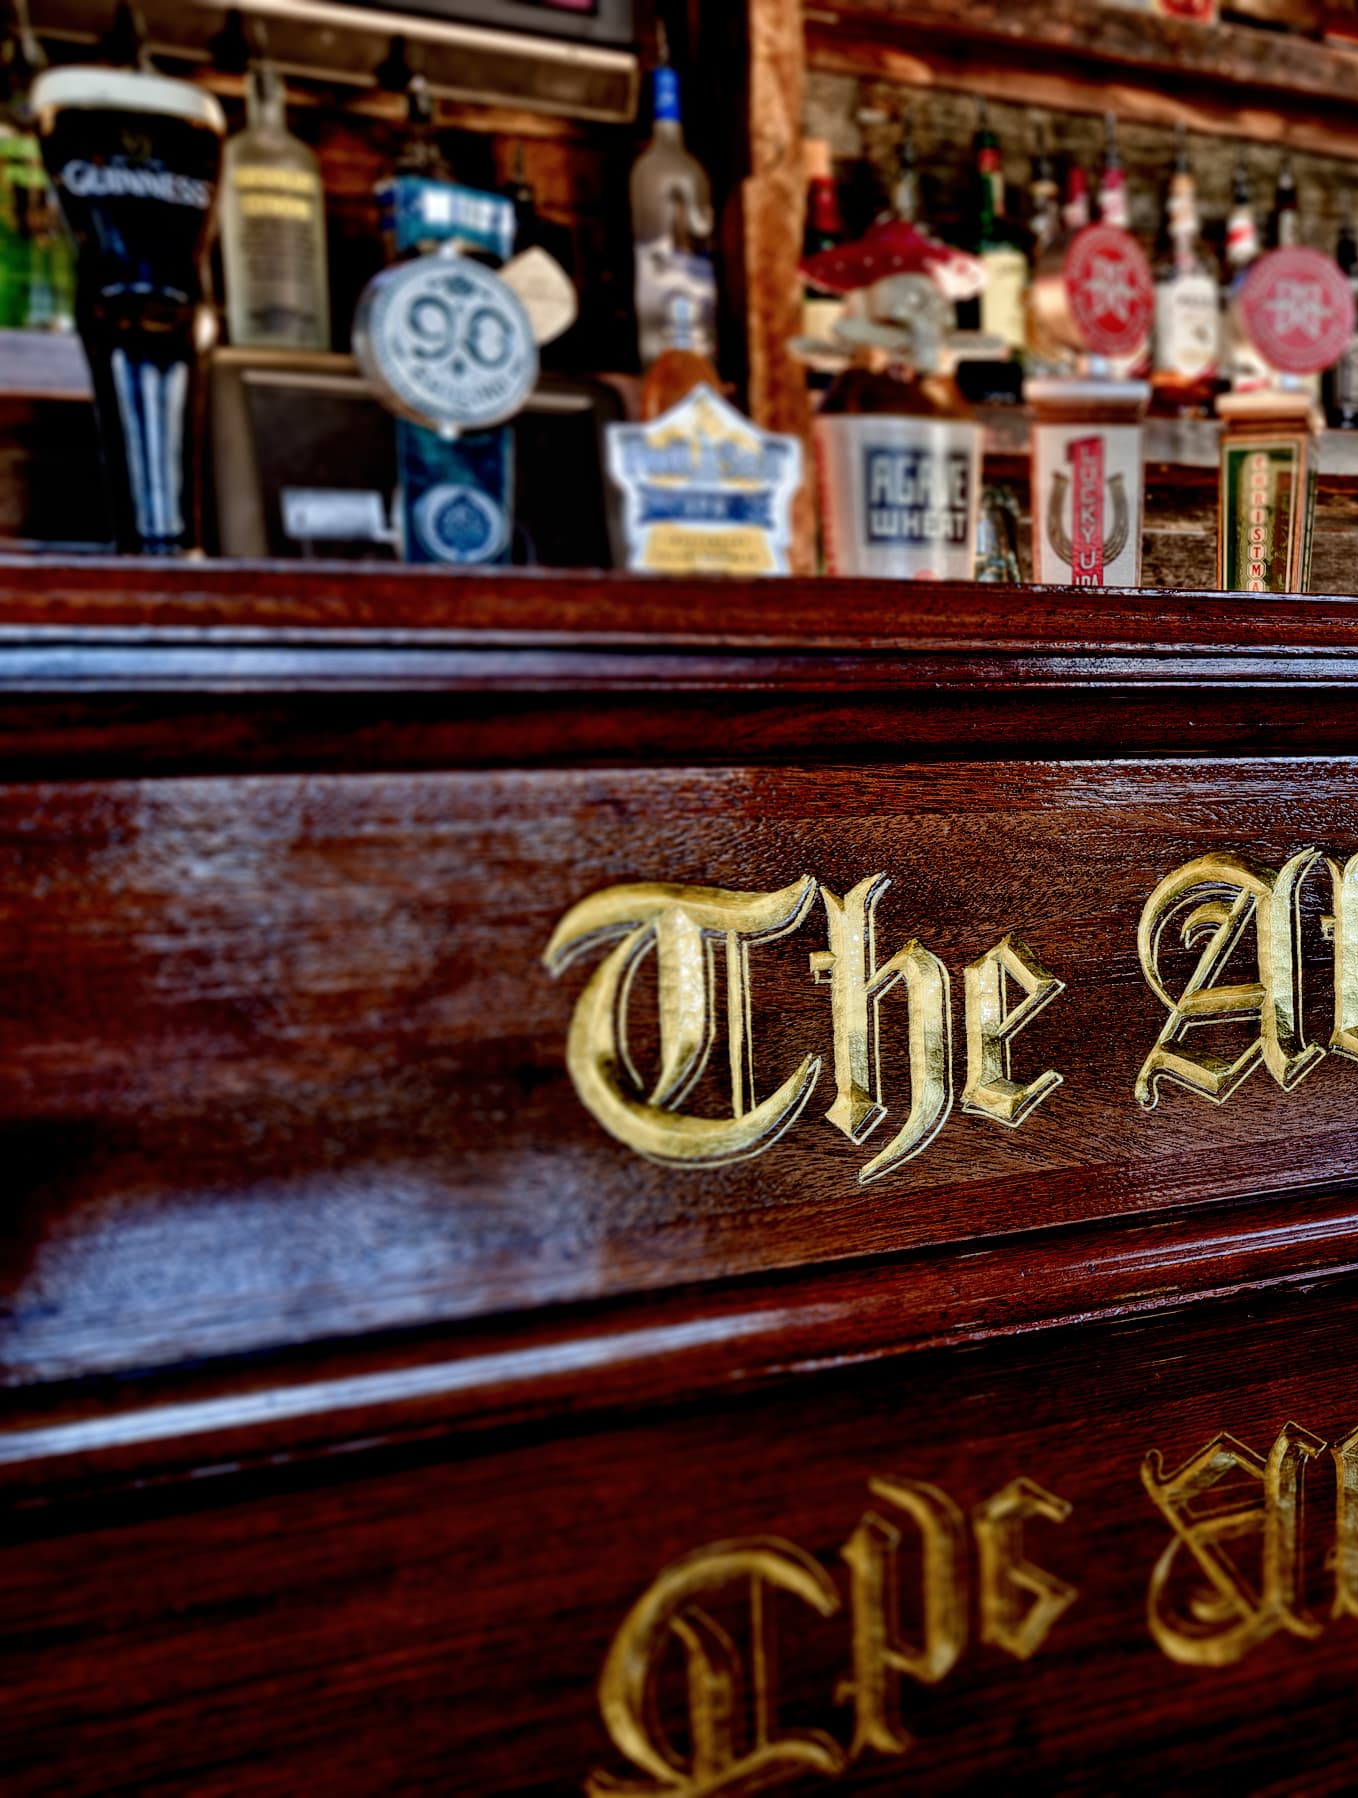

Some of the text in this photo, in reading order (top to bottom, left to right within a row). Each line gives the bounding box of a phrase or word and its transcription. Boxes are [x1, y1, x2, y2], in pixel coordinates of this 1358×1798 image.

[408, 295, 516, 369] 90
[872, 457, 969, 506] AGAE
[1079, 446, 1097, 570] LUCKY U
[1251, 456, 1264, 592] CHRISTMA
[541, 870, 1066, 1185] The
